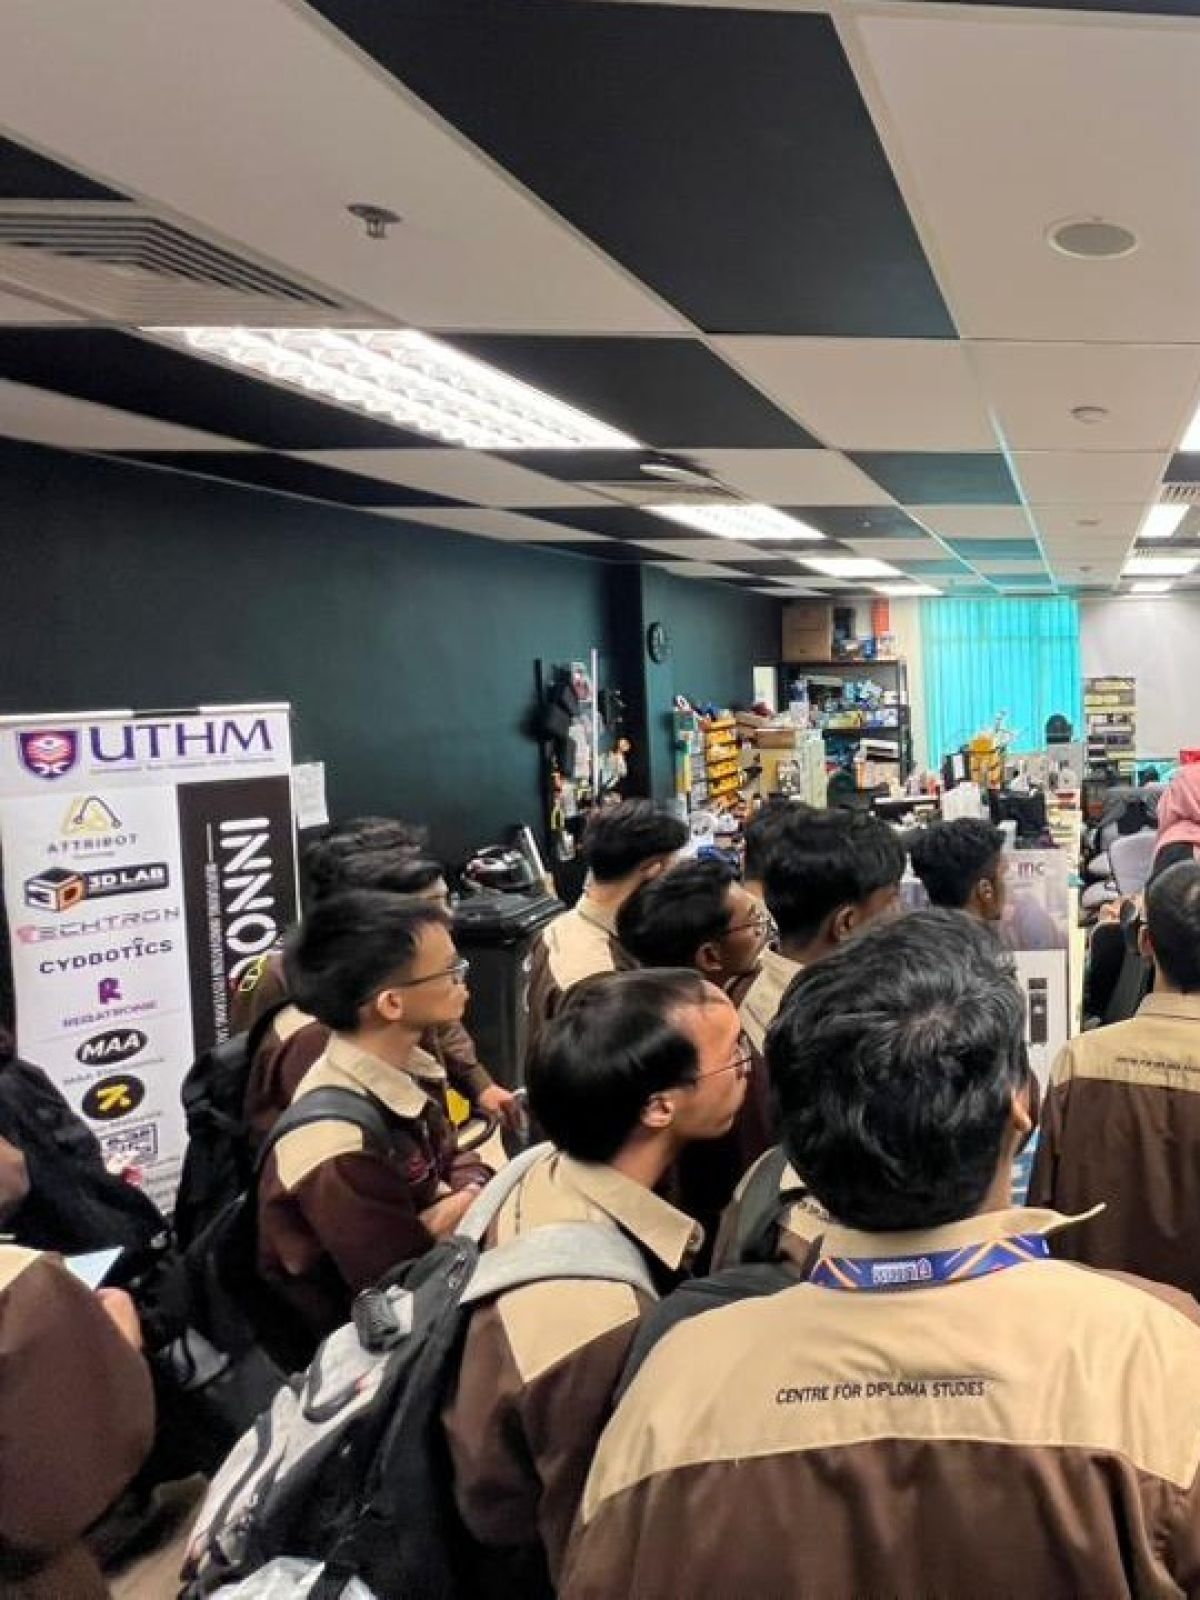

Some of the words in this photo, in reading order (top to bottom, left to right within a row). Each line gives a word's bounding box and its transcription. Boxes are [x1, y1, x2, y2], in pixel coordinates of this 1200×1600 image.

[89, 719, 273, 761] UTHM
[88, 867, 166, 889] 3DLAB
[81, 1030, 141, 1061] MAA
[776, 1386, 830, 1405] CENTRE
[833, 1382, 862, 1401] FOR
[866, 1380, 927, 1399] DIPLOMA
